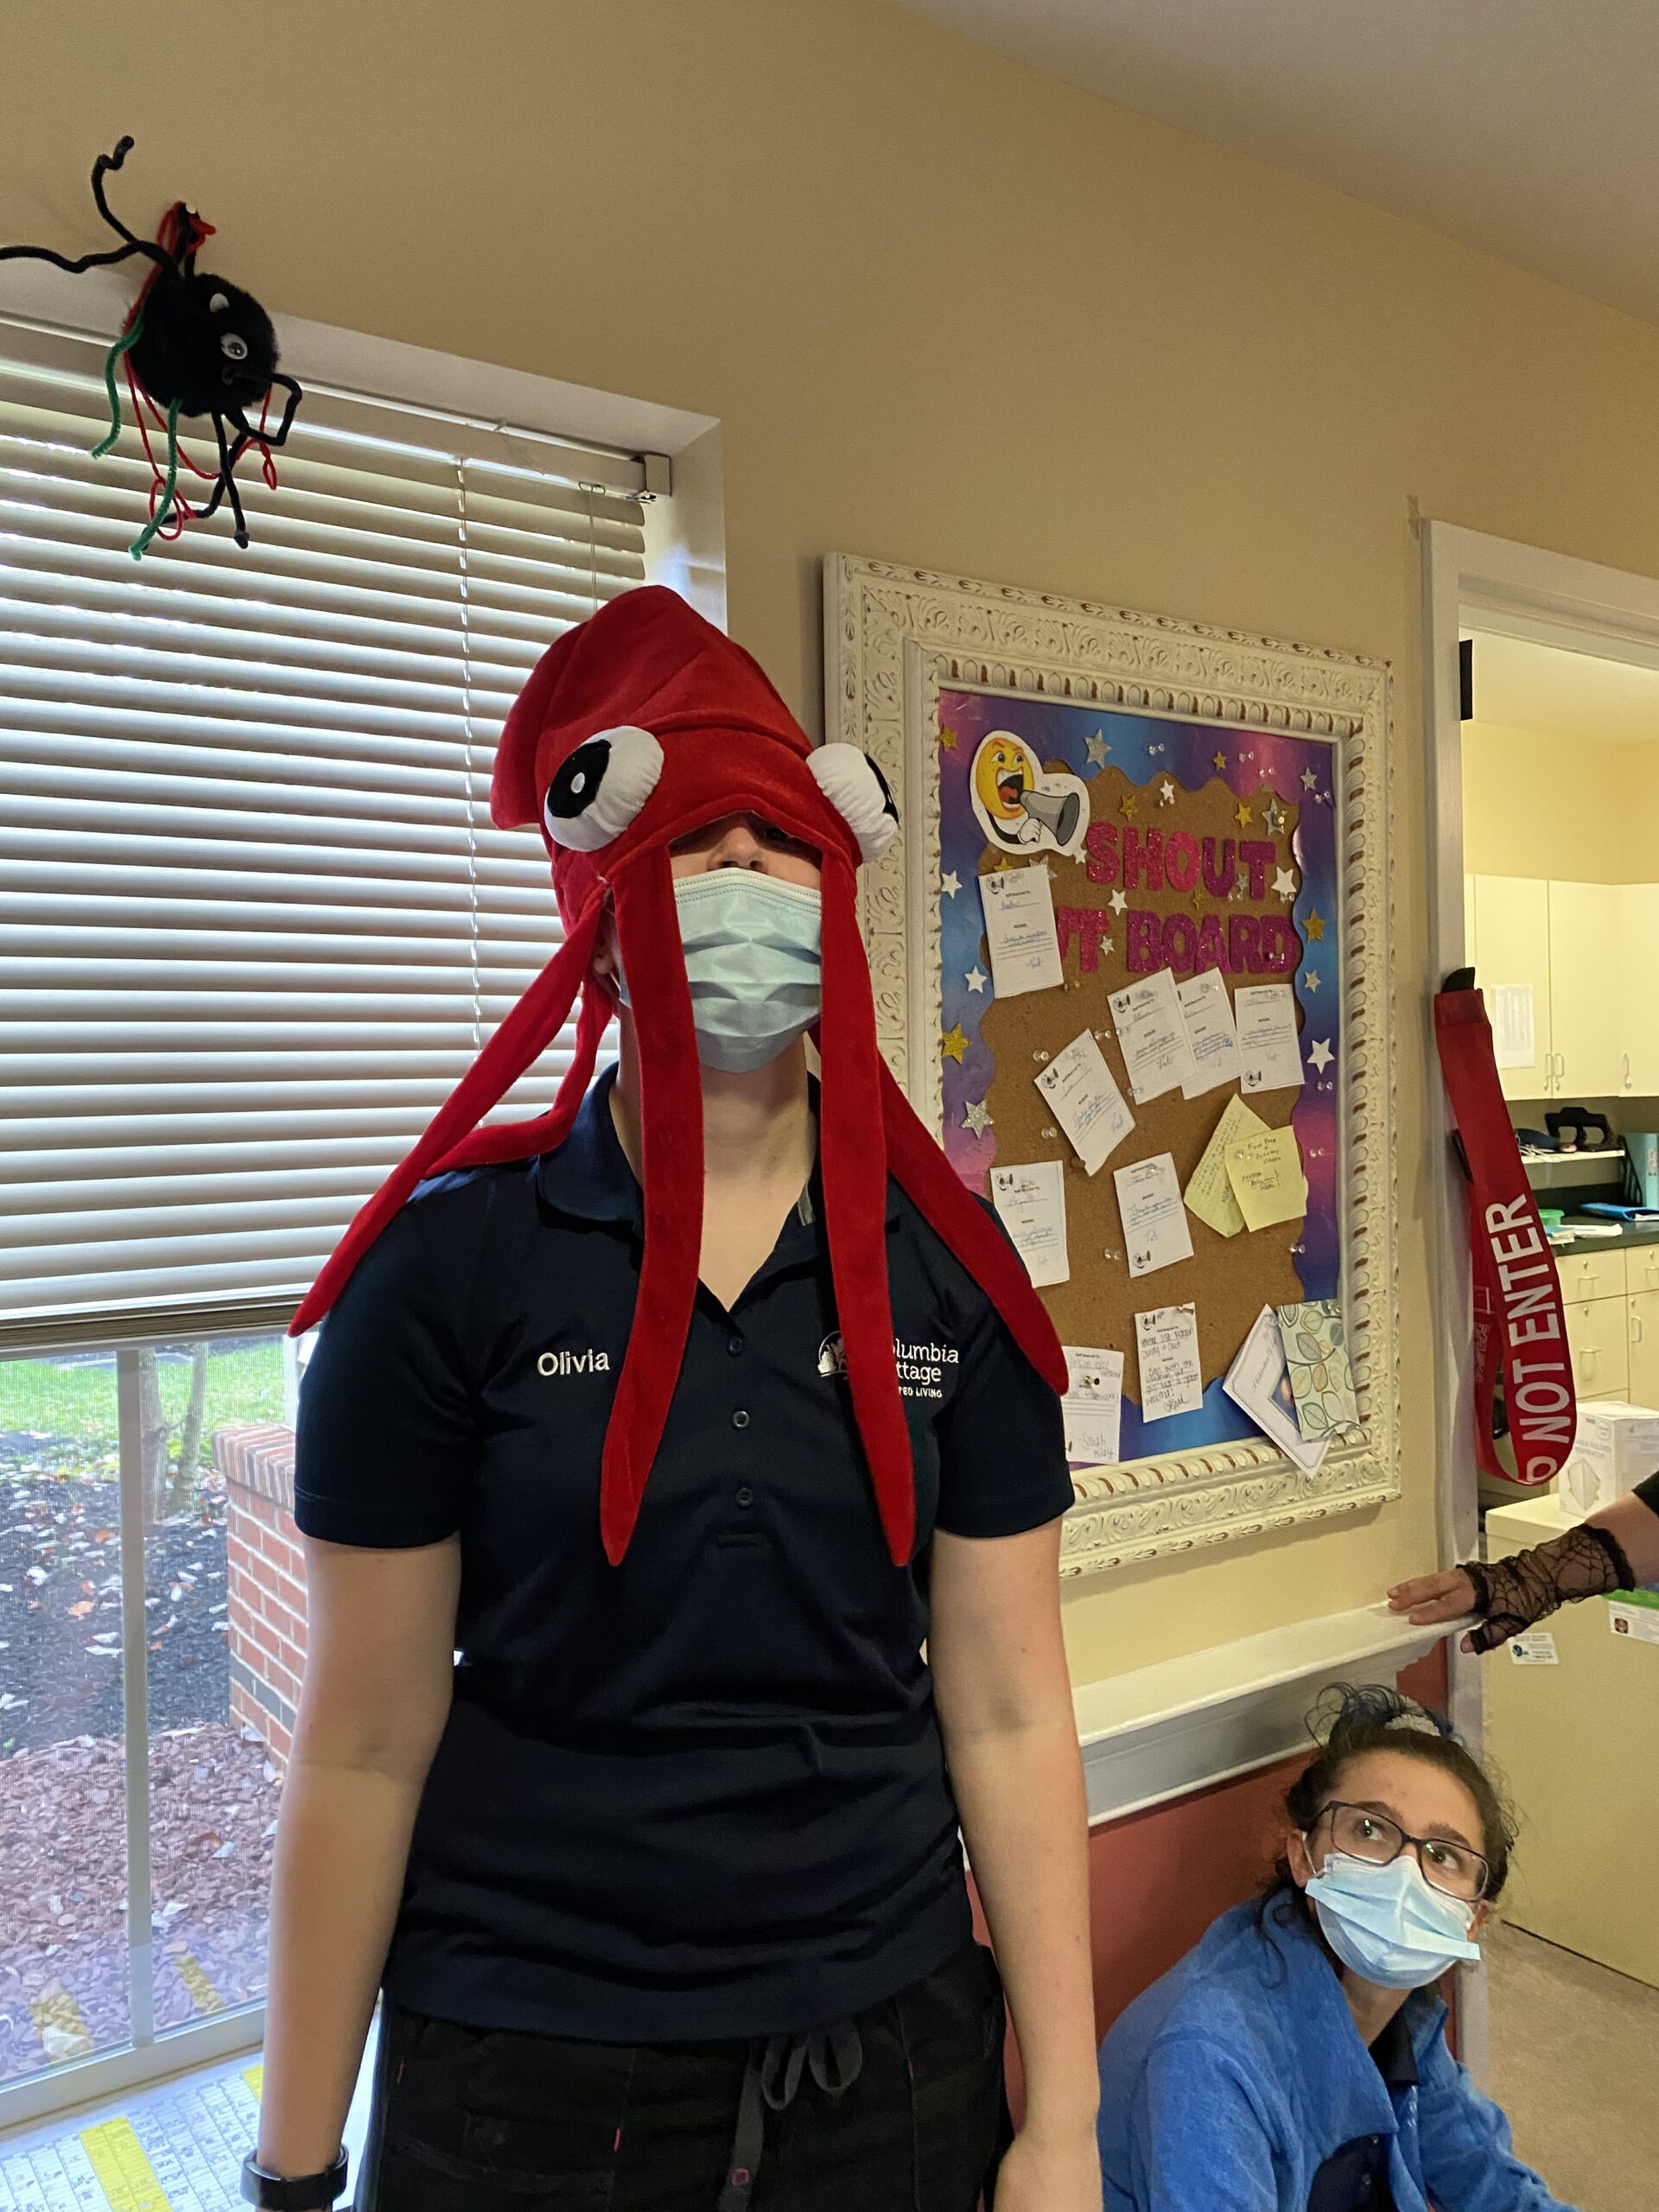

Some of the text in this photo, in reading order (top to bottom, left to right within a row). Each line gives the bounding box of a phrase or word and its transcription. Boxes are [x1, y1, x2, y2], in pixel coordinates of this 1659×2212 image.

[1086, 821, 1276, 899] SHOUT
[1128, 910, 1299, 974] BOARD
[1485, 1194, 1560, 1346] ENTER
[537, 1349, 610, 1376] Olivia
[893, 1338, 959, 1363] lumbia
[896, 1361, 942, 1386] ttage
[915, 1388, 943, 1398] LIVING
[1512, 1359, 1571, 1443] NOT
